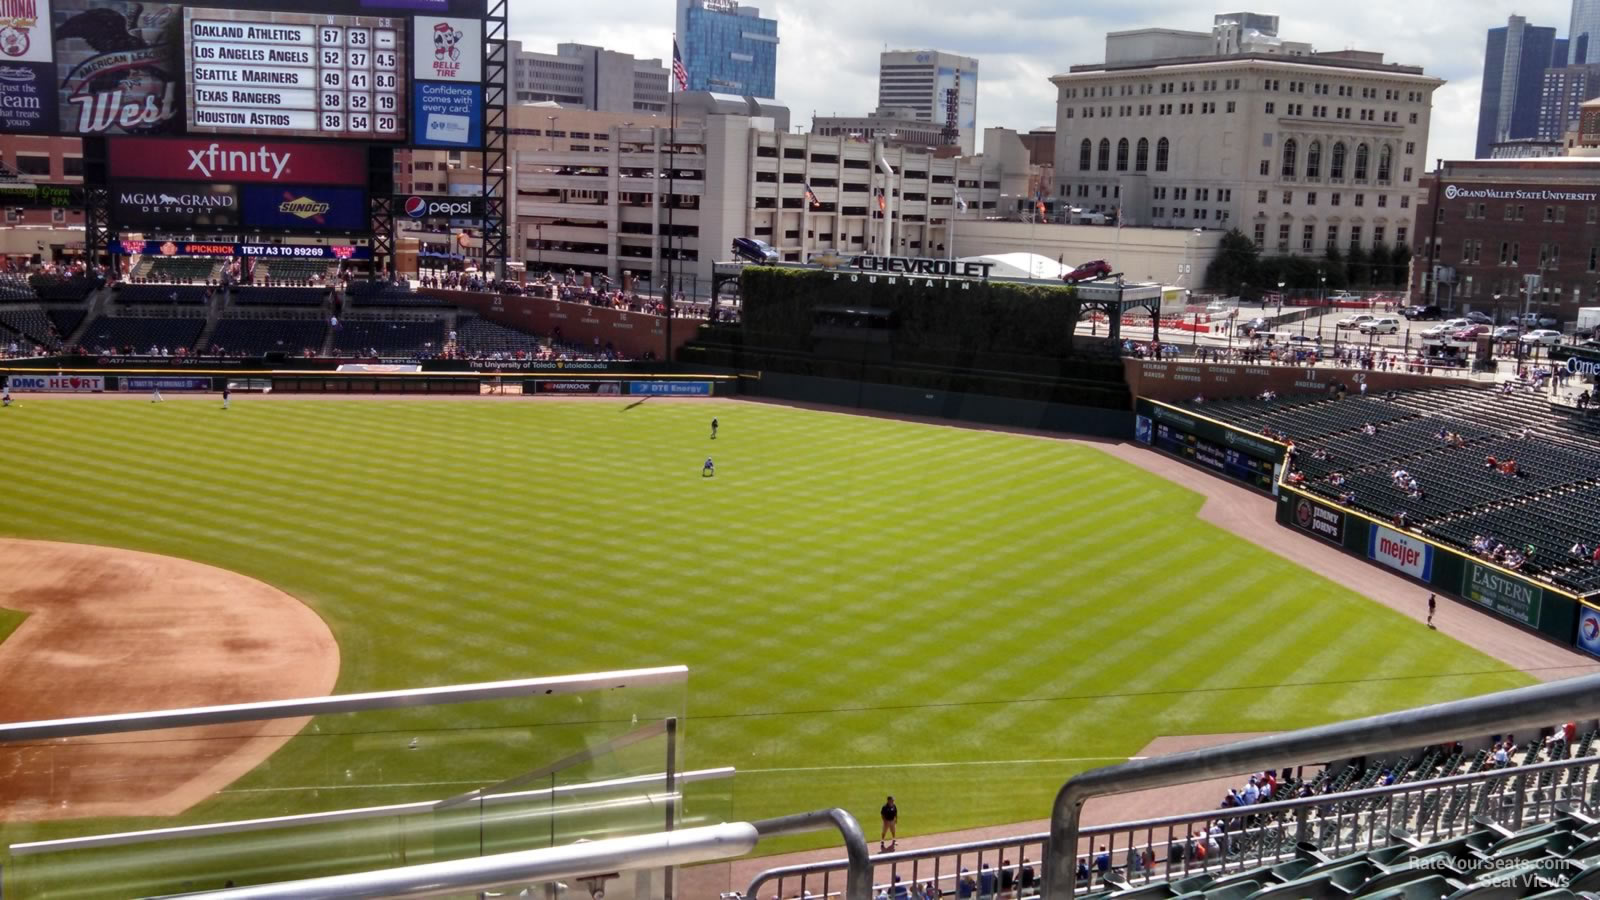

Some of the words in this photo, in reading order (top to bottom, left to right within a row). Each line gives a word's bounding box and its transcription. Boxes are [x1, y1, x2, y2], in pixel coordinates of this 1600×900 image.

[327, 15, 335, 25] W
[355, 17, 361, 26] L
[194, 24, 243, 38] OAKLAND
[247, 26, 301, 41] ATHLETICS
[324, 30, 338, 43] 57
[351, 32, 366, 44] 33
[195, 46, 214, 59] LOS
[218, 47, 265, 61] ANGELES
[269, 49, 309, 63] ANGELS
[324, 52, 339, 64] 52
[351, 53, 366, 66] 37
[377, 54, 395, 67] 4.5
[79, 55, 127, 78] AMERICAN
[433, 61, 460, 70] BELLE
[195, 68, 238, 81] SEATTLE
[242, 70, 299, 84] MARINERS
[436, 69, 456, 77] TIRE
[324, 73, 340, 86] 49
[351, 75, 366, 87] 41
[376, 75, 395, 88] 8.0
[22, 84, 36, 93] the
[422, 85, 472, 96] Confidence
[196, 89, 228, 102] TEXAS
[232, 91, 281, 104] RANGERS
[325, 94, 340, 107] 38
[352, 96, 366, 108] 52
[422, 95, 451, 104] comes
[453, 96, 472, 105] with
[69, 81, 177, 134] West
[379, 97, 394, 109] 19
[422, 104, 447, 114] every
[449, 105, 470, 113] card.
[16, 110, 40, 118] treats
[197, 110, 246, 124] HOUSTON
[250, 112, 290, 126] ASTROS
[6, 119, 30, 127] yours
[325, 115, 340, 128] 38
[352, 117, 367, 129] 54
[380, 118, 394, 130] 20
[187, 143, 289, 179] xfinity
[42, 186, 69, 198] Green
[1456, 188, 1486, 198] GRAND
[1486, 189, 1516, 199] VALLEY
[1516, 190, 1541, 200] STATE
[1542, 190, 1597, 201] UNIVERSITY
[120, 193, 158, 205] MGM
[180, 195, 233, 207] GRAND
[142, 206, 213, 214] DETROIT
[281, 202, 328, 214] SUNOCO
[429, 201, 471, 215] pepsi
[185, 244, 235, 254] #PICKRICK
[242, 246, 264, 254] TEXT
[265, 246, 278, 255] A3
[280, 247, 292, 256] TO
[294, 247, 324, 256] 89269
[858, 255, 995, 278] CHEVROLET
[833, 273, 970, 290] FOUNTAIN
[484, 361, 521, 369] University
[532, 361, 556, 369] Toledo
[1306, 370, 1316, 380] 11
[1352, 373, 1366, 383] 42
[12, 379, 45, 388] DMC
[651, 384, 669, 392] DTE
[671, 384, 702, 393] Energy
[1295, 380, 1326, 389] ANDERSON
[1313, 506, 1339, 525] JIMMY
[1312, 519, 1338, 537] JOHN'S
[1380, 537, 1420, 566] meijer
[1472, 564, 1533, 604] EASTERN
